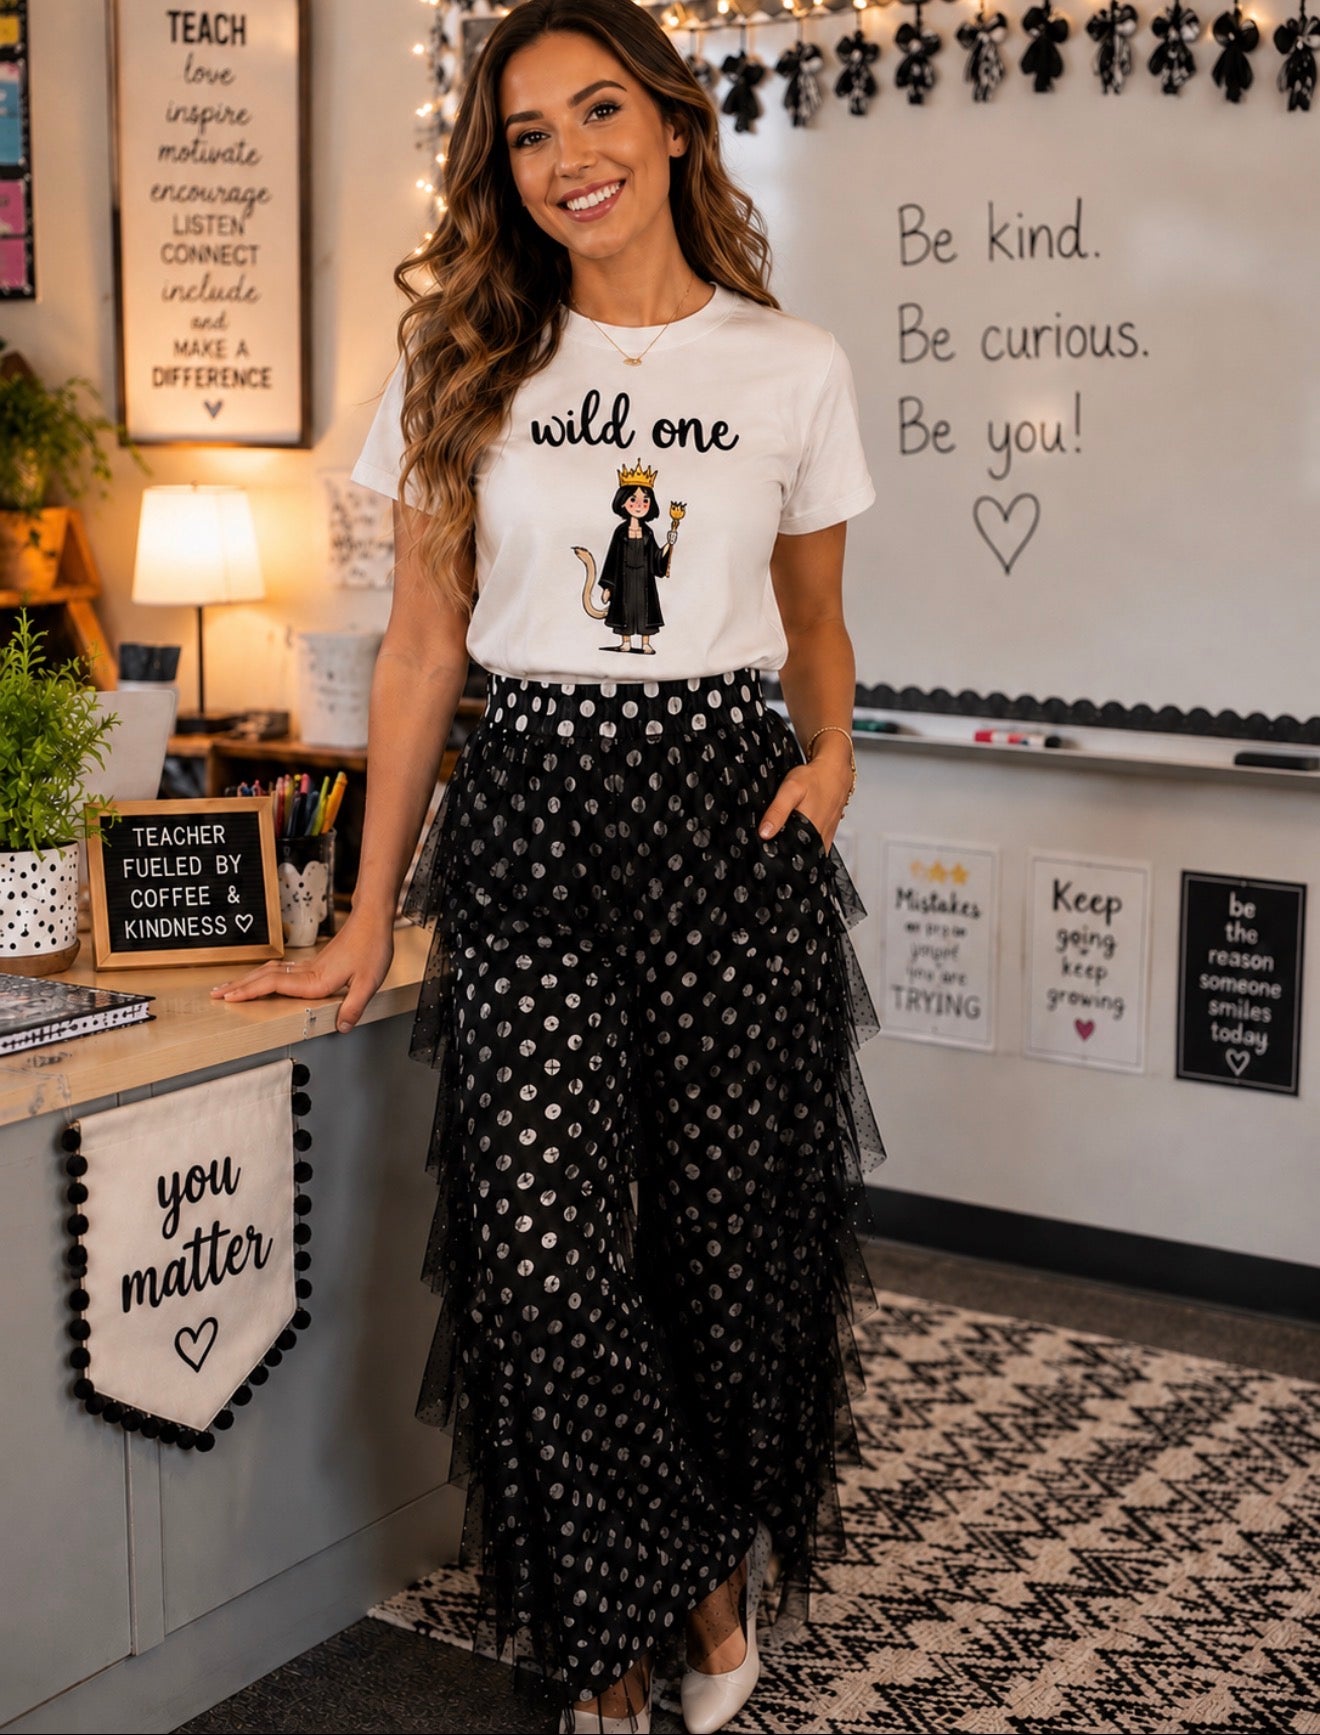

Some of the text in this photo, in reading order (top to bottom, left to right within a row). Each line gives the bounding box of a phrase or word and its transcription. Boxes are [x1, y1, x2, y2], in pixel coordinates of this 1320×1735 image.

[166, 10, 247, 47] TEACH
[183, 52, 236, 86] love
[165, 100, 250, 134] inspire
[158, 138, 260, 167] motivate
[150, 183, 270, 218] encourage
[173, 213, 245, 236] LISTEN
[899, 196, 1101, 266] Be kind.
[160, 244, 260, 267] CONNECT
[161, 272, 259, 303] include
[190, 310, 228, 331] and
[899, 302, 1149, 364] Be curious.
[173, 340, 250, 359] MAKE A
[153, 367, 272, 389] DIFFERENCE
[531, 389, 739, 453] wild one
[899, 391, 1082, 481] Be you!
[132, 824, 226, 847] TEACHER
[123, 854, 242, 878] FUELED BY
[130, 885, 241, 909] COFFEE &
[895, 888, 981, 920] Mistakes
[1052, 878, 1123, 925] Keep
[1229, 891, 1256, 919] be
[124, 916, 227, 940] KINDNESS
[1055, 926, 1117, 959] going
[1224, 920, 1258, 945] the
[1061, 958, 1108, 985] keep
[1208, 947, 1275, 972] reason
[890, 984, 981, 1021] TRYING
[1199, 974, 1282, 1000] someone
[1045, 988, 1125, 1021] growing
[1208, 999, 1272, 1023] smiles
[1211, 1023, 1269, 1056] today
[157, 1155, 241, 1240] you
[121, 1220, 273, 1314] matter
